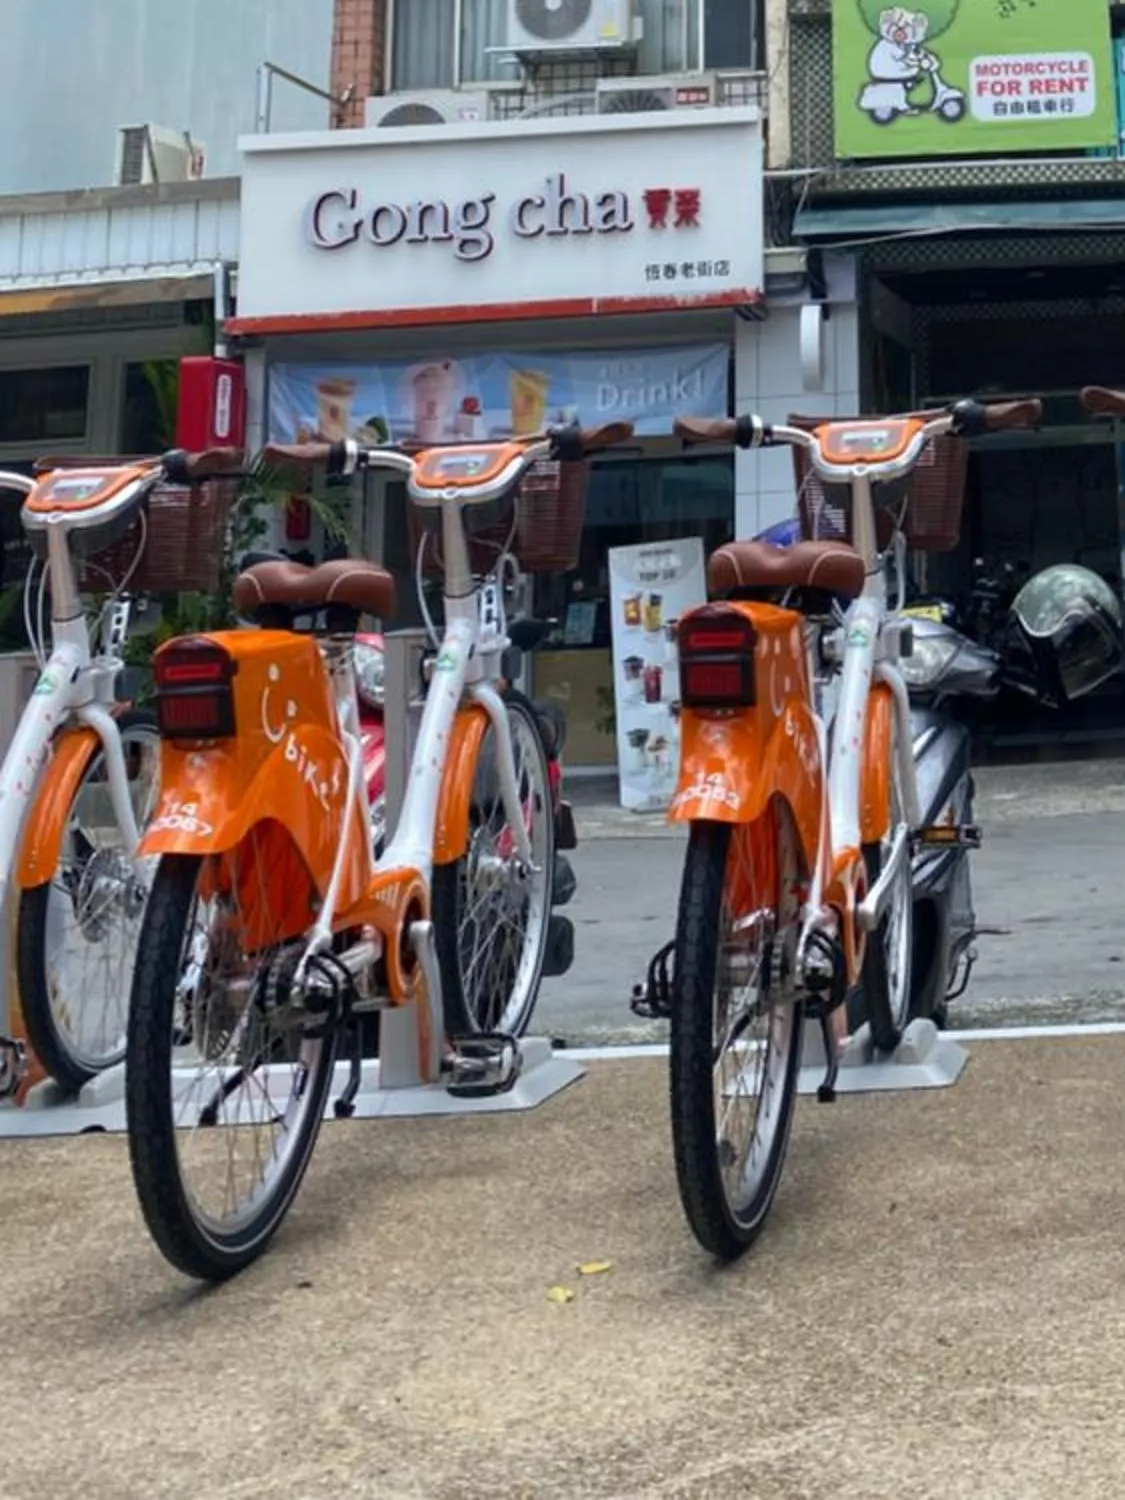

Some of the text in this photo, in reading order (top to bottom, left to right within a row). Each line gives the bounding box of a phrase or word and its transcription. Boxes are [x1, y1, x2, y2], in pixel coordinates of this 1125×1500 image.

[975, 60, 1089, 76] MOTORCYCLE
[976, 77, 1089, 97] FOR RENT
[308, 174, 635, 261] Gong cha
